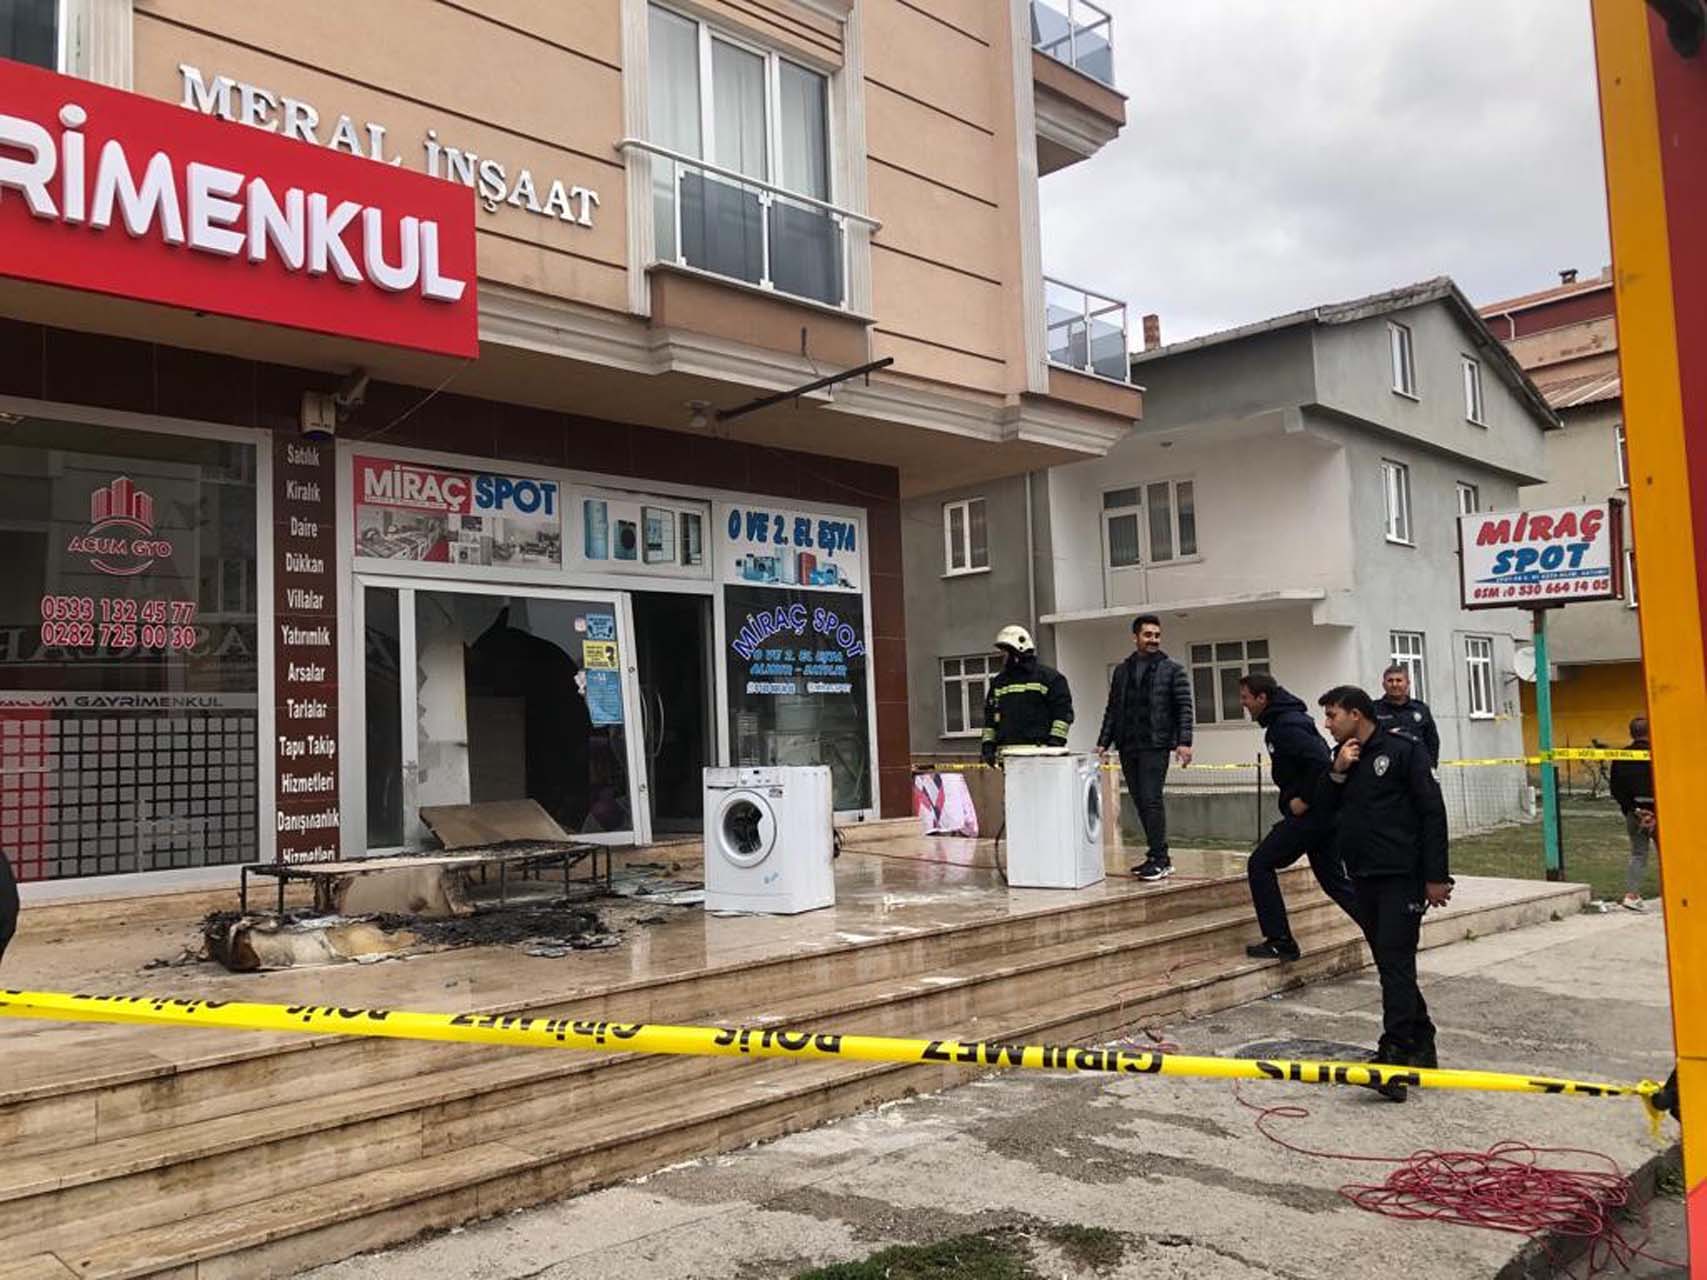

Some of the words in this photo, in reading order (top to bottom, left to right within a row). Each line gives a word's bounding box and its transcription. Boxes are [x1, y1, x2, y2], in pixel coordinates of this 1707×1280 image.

[178, 63, 404, 167] MERAL
[423, 130, 600, 228] İNŞAAT
[287, 443, 320, 466] Satılık
[286, 480, 320, 502] Kiralık
[364, 464, 466, 512] MİRAÇ
[475, 474, 557, 515] SPOT
[290, 516, 318, 538] Daire
[746, 511, 769, 543] VE
[773, 514, 789, 545] 2.
[794, 517, 814, 548] EL
[818, 519, 855, 557] EŞYA
[1476, 509, 1604, 546] MİRAÇ
[68, 536, 128, 555] ACUM
[131, 539, 172, 558] GYO
[285, 552, 324, 574] Dükkan
[1491, 543, 1590, 575] SPOT
[287, 588, 324, 609] Villalar
[1474, 587, 1499, 599] GSM
[1519, 584, 1541, 596] 530
[1574, 581, 1587, 592] 14
[1593, 579, 1609, 590] 05
[41, 595, 94, 621] 0533
[100, 598, 137, 622] 132
[142, 600, 166, 624] 45
[171, 602, 196, 625] 77
[41, 621, 94, 646] 0282
[100, 623, 137, 647] 725
[142, 625, 166, 648] 00
[171, 626, 196, 649] 30
[281, 624, 331, 646] Yatırımlık
[731, 603, 807, 660] MİRAÇ
[813, 607, 866, 658] SPOT
[288, 662, 326, 682] Arsalar
[74, 693, 224, 708] GAYRİMENKUL
[286, 699, 327, 719] Tarlalar
[279, 736, 305, 760] Tapu
[307, 735, 336, 759] Takip
[282, 771, 335, 794] Hizmetleri
[277, 808, 339, 836] Danışmanlık
[282, 844, 335, 864] Hizmetleri
